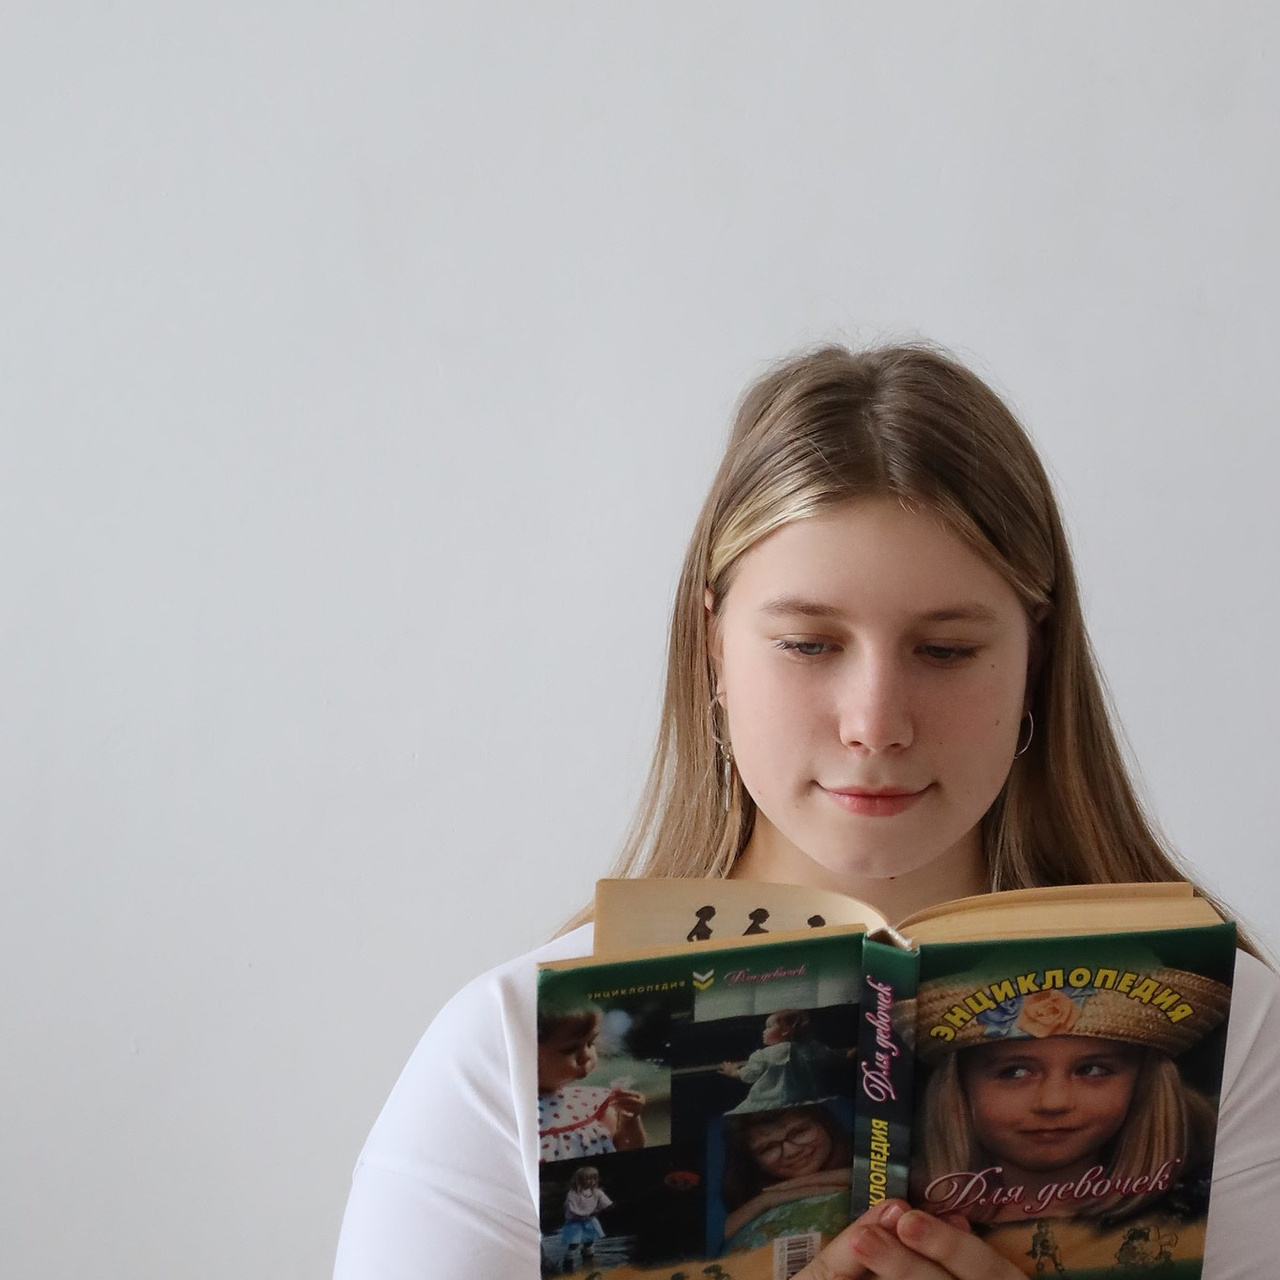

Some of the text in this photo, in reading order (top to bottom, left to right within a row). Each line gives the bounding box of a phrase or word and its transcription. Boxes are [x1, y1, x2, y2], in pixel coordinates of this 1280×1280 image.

[861, 974, 899, 1102] Для девочек
[930, 967, 1194, 1042] ЭНЦИКЛОПЕДИЯ
[868, 1118, 890, 1210] КЛОПЕДИЯ
[924, 1158, 1182, 1214] Для девочек
